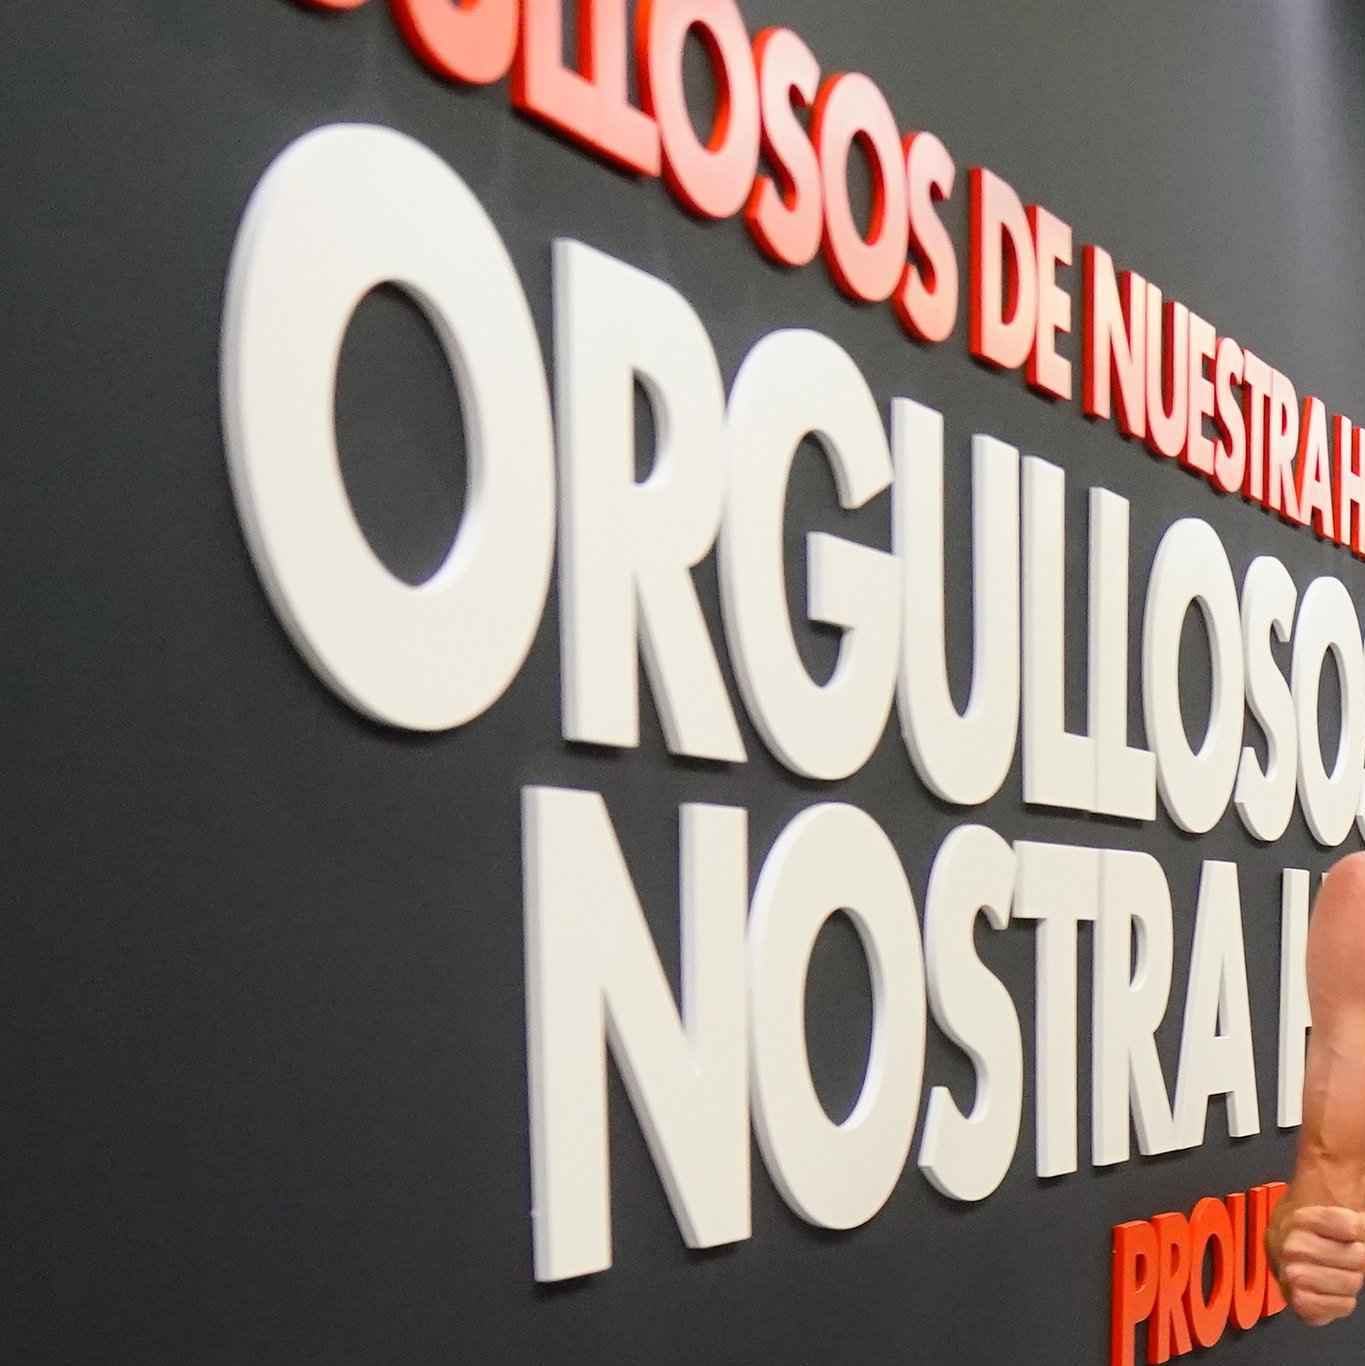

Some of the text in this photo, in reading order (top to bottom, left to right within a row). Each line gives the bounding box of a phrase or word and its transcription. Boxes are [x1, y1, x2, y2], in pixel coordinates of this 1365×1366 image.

[280, 0, 960, 343] LLOSOS
[967, 166, 1072, 401] DE
[1082, 243, 1335, 542] NUESTRA
[521, 785, 1260, 1283] NOSTRA
